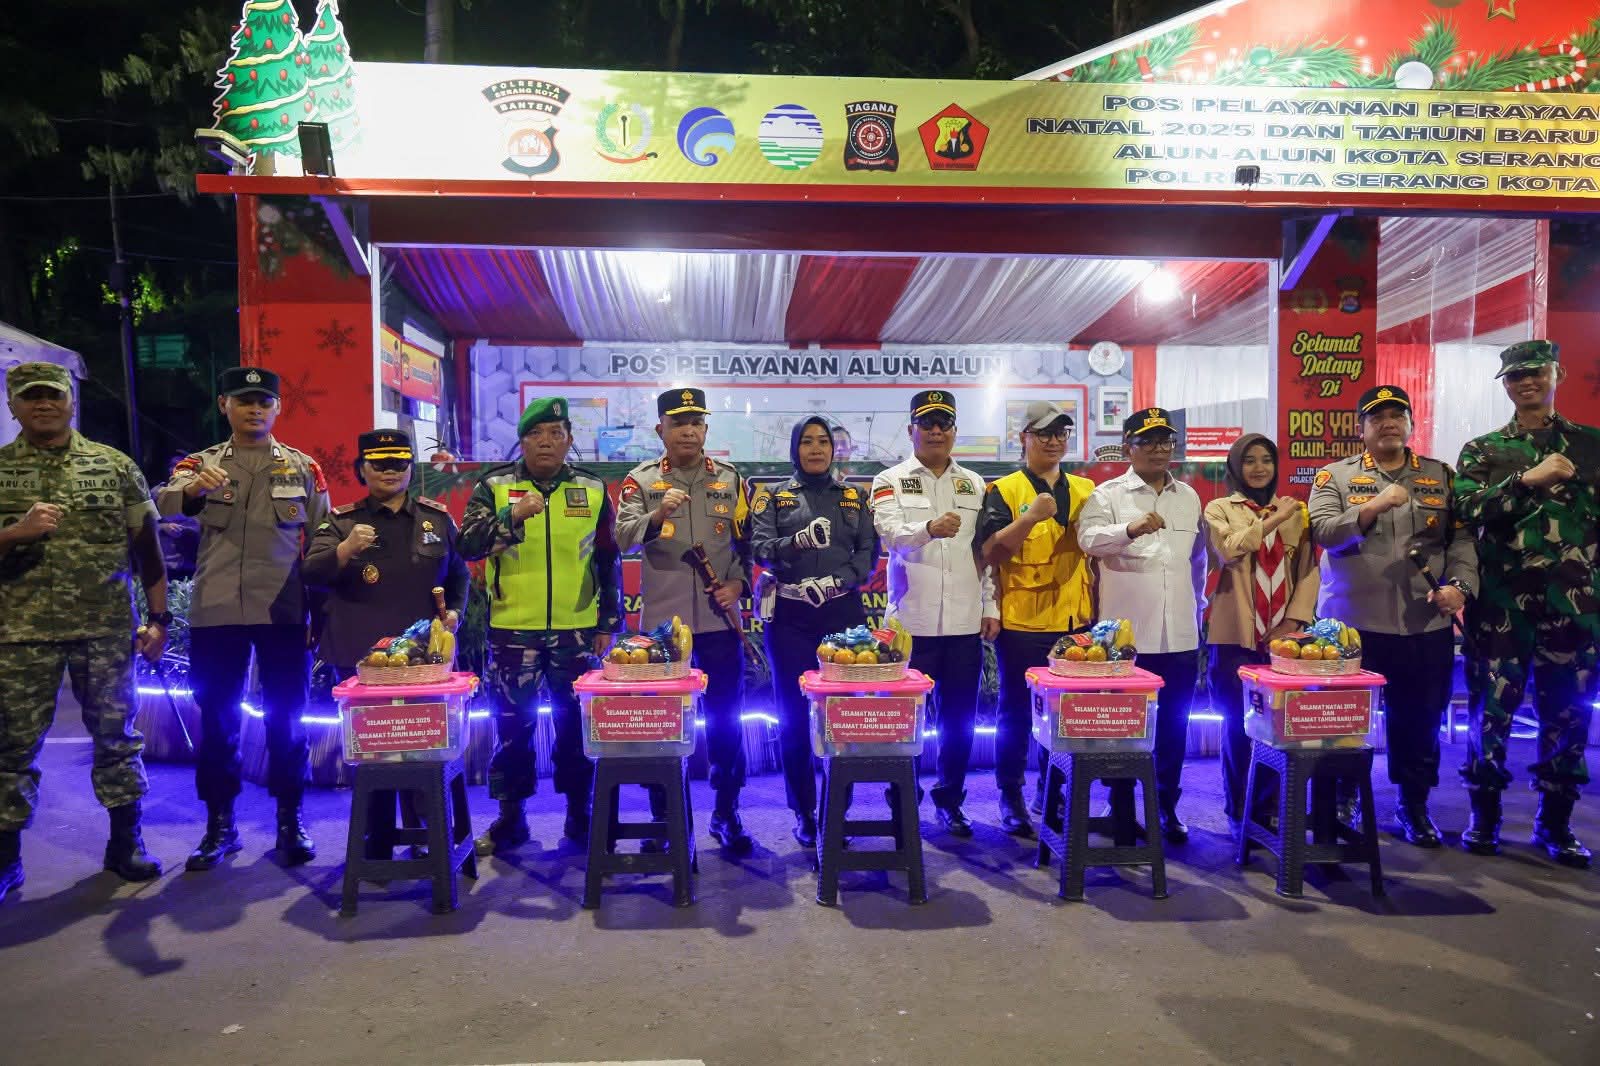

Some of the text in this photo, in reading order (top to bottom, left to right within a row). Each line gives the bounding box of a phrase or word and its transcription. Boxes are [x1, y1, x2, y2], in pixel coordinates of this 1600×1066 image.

[491, 80, 560, 94] POLRESTA
[494, 87, 559, 99] SERANG KOTA
[500, 101, 553, 113] BANTEN
[847, 102, 895, 113] TAGANA
[1103, 95, 1600, 121] POS PELAYANAN PERAYAA
[1027, 118, 1598, 145] NATAL 2025 DAN TAHUN BARU
[1113, 144, 1336, 163] ALUN-ALUN
[1345, 148, 1448, 166] KOTA
[1126, 168, 1599, 193] POLRSTA SERANG KOTA
[1291, 331, 1362, 355] Selamat
[610, 353, 1004, 377] POS PELAYANAN ALUN-ALUN
[1300, 354, 1363, 380] Datang
[1320, 379, 1341, 397] Di
[1289, 411, 1324, 437] POS
[1290, 441, 1365, 457] ALUN-ALUN
[76, 479, 117, 488] TNI AD
[1289, 476, 1315, 484] POLRES
[706, 491, 732, 500] POLRI
[1348, 485, 1379, 494] YUDHA
[1413, 487, 1444, 495] POLRI
